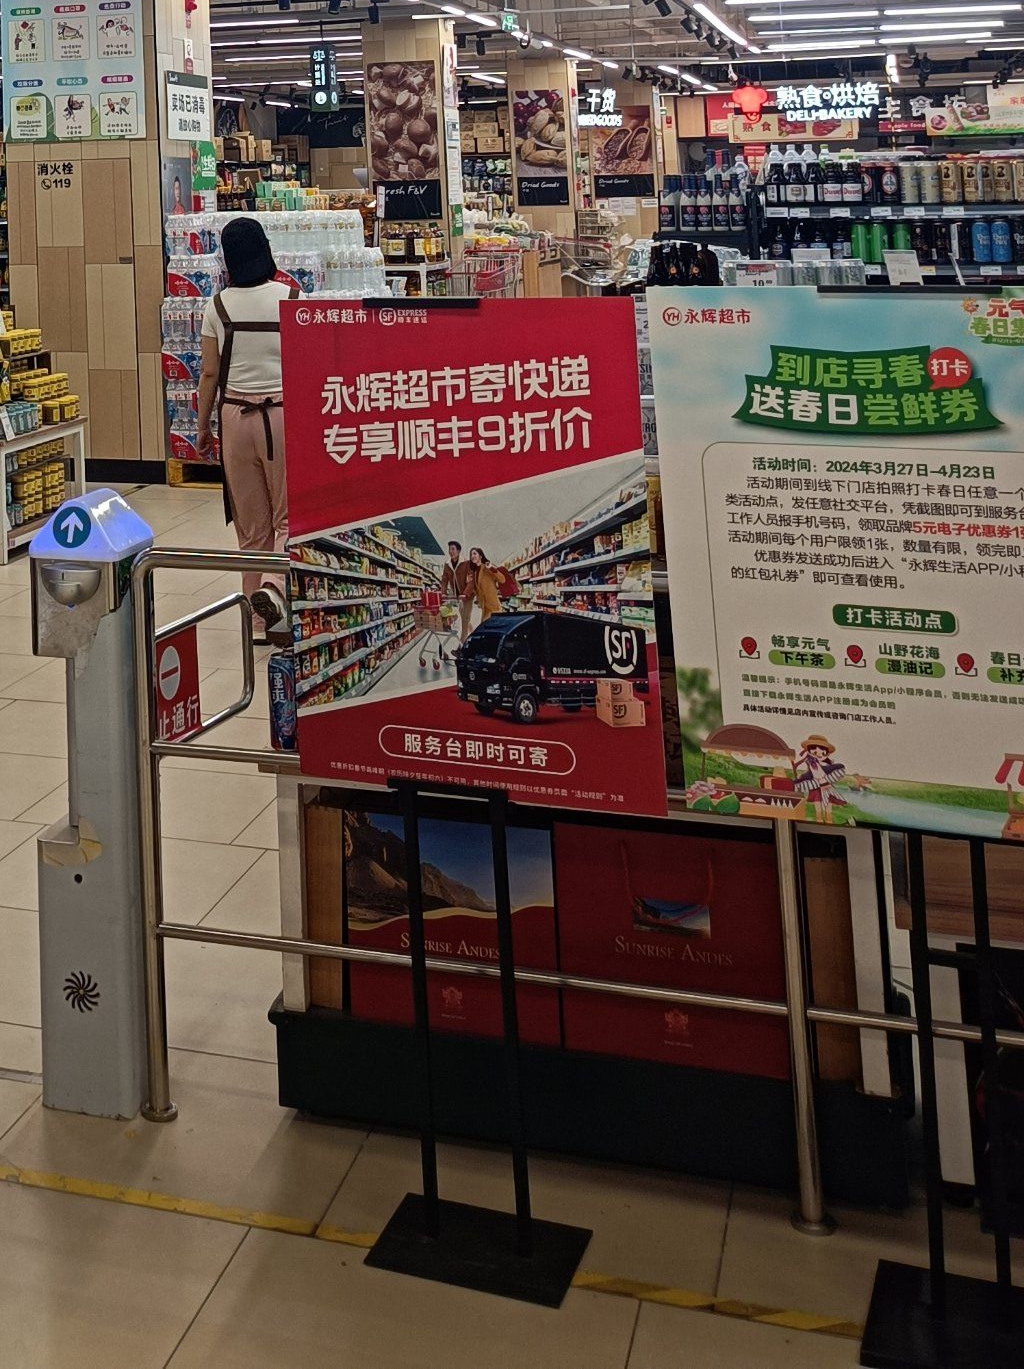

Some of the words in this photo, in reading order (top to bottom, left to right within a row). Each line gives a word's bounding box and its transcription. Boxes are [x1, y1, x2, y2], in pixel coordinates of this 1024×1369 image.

[586, 86, 617, 113] 干货
[37, 162, 74, 176] 消火栓
[53, 178, 71, 188] 119
[385, 185, 405, 196] resh
[313, 309, 367, 324] 永辉超市
[684, 308, 751, 326] 永辉超市
[776, 352, 925, 390] 到店寻春
[930, 358, 969, 378] 打卡
[321, 354, 591, 415] 永辉超市寄快递
[749, 382, 979, 427] 送春日尝鲜券
[323, 406, 593, 465] 专享顺丰9折价
[846, 607, 942, 630] 打卡活动点
[610, 629, 632, 660] SF
[771, 634, 831, 651] 畅享元气
[878, 642, 940, 660] 山野花海
[780, 651, 824, 667] 下午茶
[887, 659, 933, 675] 漫油记
[990, 651, 1024, 667] 春日
[159, 694, 200, 739] 止通行
[404, 732, 548, 767] 服务台即时可寄
[400, 932, 453, 954] SRISE
